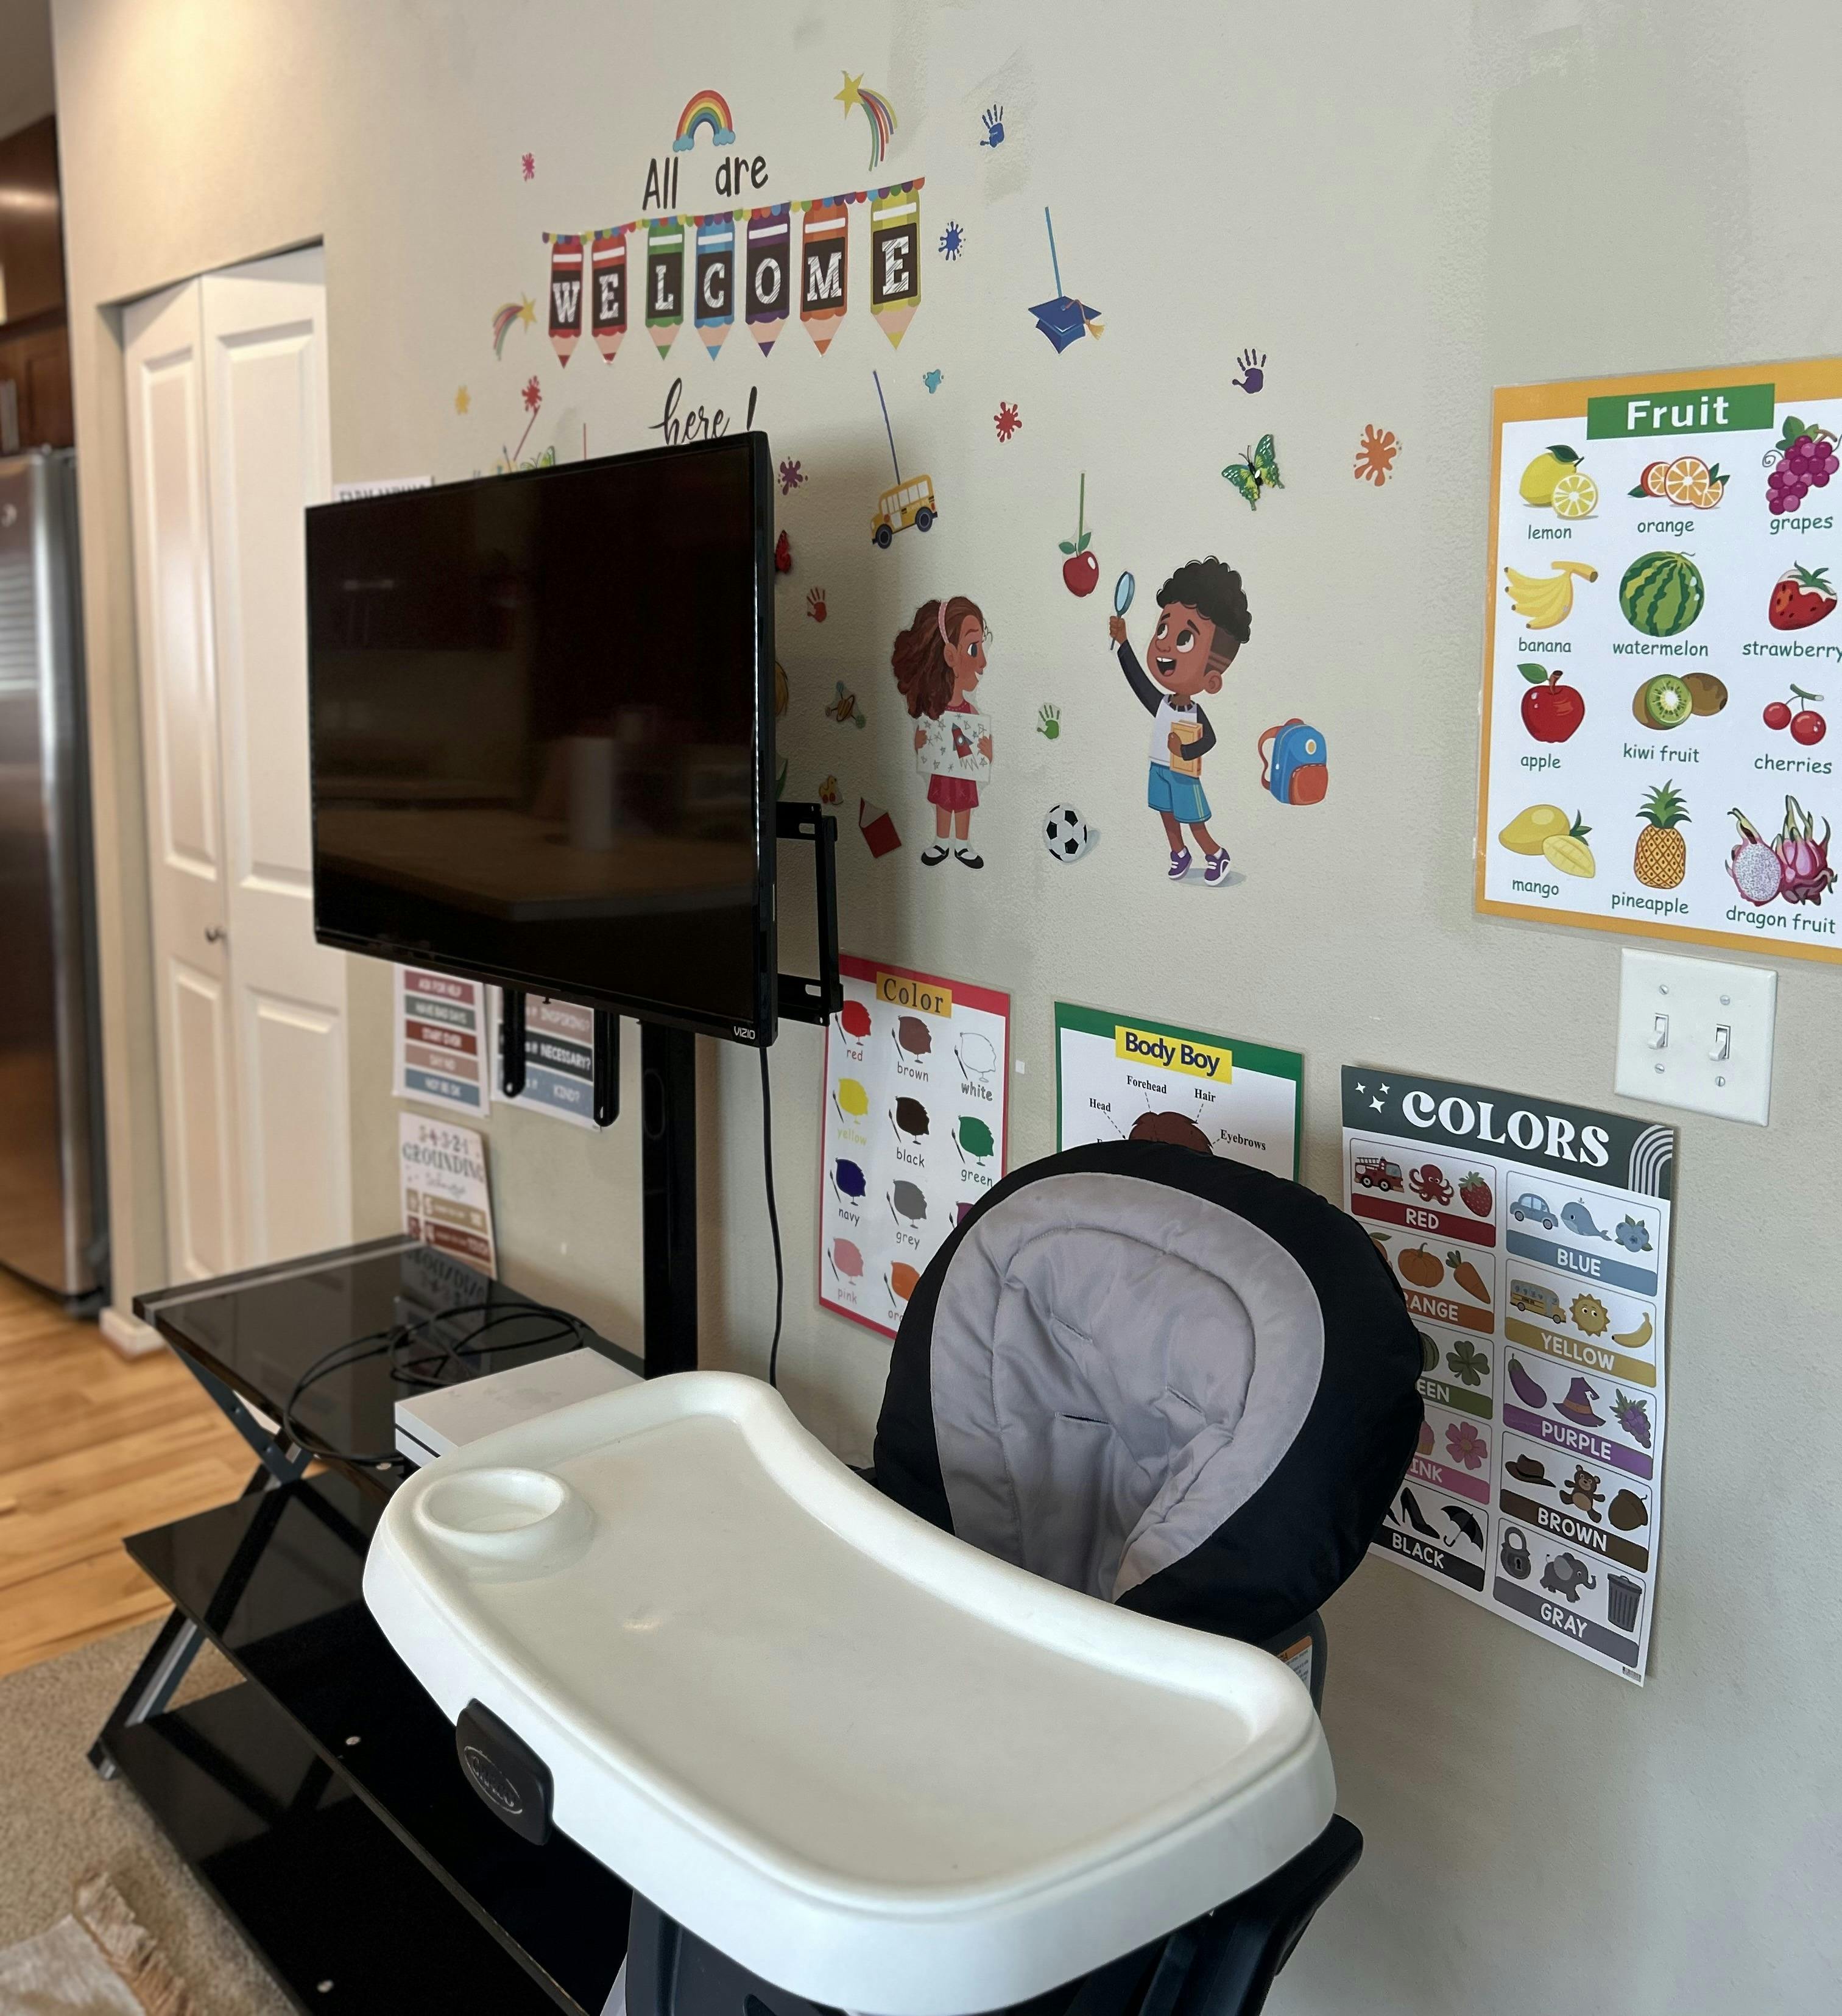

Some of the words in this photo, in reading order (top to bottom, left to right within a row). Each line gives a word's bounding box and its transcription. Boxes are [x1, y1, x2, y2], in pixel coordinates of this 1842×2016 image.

[641, 157, 679, 211] All
[715, 155, 769, 199] are
[551, 235, 910, 324] WELCOME
[648, 377, 730, 445] here
[1626, 395, 1729, 431] Fruit
[1527, 524, 1572, 541] lemon
[1636, 520, 1695, 538] orange
[1769, 516, 1834, 535] grapes
[1518, 637, 1572, 654] banana
[1612, 641, 1709, 657] watermelon
[1741, 640, 1842, 664] strawberry
[1520, 753, 1561, 772] apple
[1623, 742, 1655, 761] kiwi
[1659, 745, 1700, 763] fruit
[1754, 754, 1833, 775] cherries
[1512, 878, 1560, 898] mango
[1611, 892, 1690, 915] pineapple
[1726, 904, 1787, 930] dragon
[1791, 913, 1836, 934] fruit
[883, 978, 944, 1013] Color
[733, 1026, 755, 1040] VIZIO
[540, 1043, 591, 1071] NECESSARY?
[846, 1048, 863, 1062] red
[1125, 1031, 1176, 1066] Body
[1180, 1043, 1221, 1077] Boy
[897, 1061, 929, 1082] brown
[961, 1081, 993, 1101] white
[1126, 1074, 1167, 1094] Forehead
[1089, 1098, 1112, 1113] Head
[1194, 1088, 1216, 1103] Hair
[837, 1128, 867, 1147] yellow
[1402, 1090, 1610, 1168] COLORS
[1219, 1129, 1266, 1151] Eyebrows
[896, 1147, 925, 1168] black
[961, 1169, 993, 1188] green
[838, 1207, 860, 1227] navy
[1405, 1208, 1439, 1230] RED
[896, 1231, 920, 1250] grey
[1557, 1249, 1601, 1278] BLUE
[838, 1287, 858, 1305] pink
[1540, 1332, 1615, 1372] YELLOW
[1416, 1378, 1450, 1403] EEN
[1541, 1420, 1612, 1461] PURPLE
[1410, 1457, 1443, 1484] INK
[1537, 1506, 1607, 1552] BROWN
[1392, 1532, 1444, 1570] BLACK
[1540, 1602, 1589, 1638] GRAY
